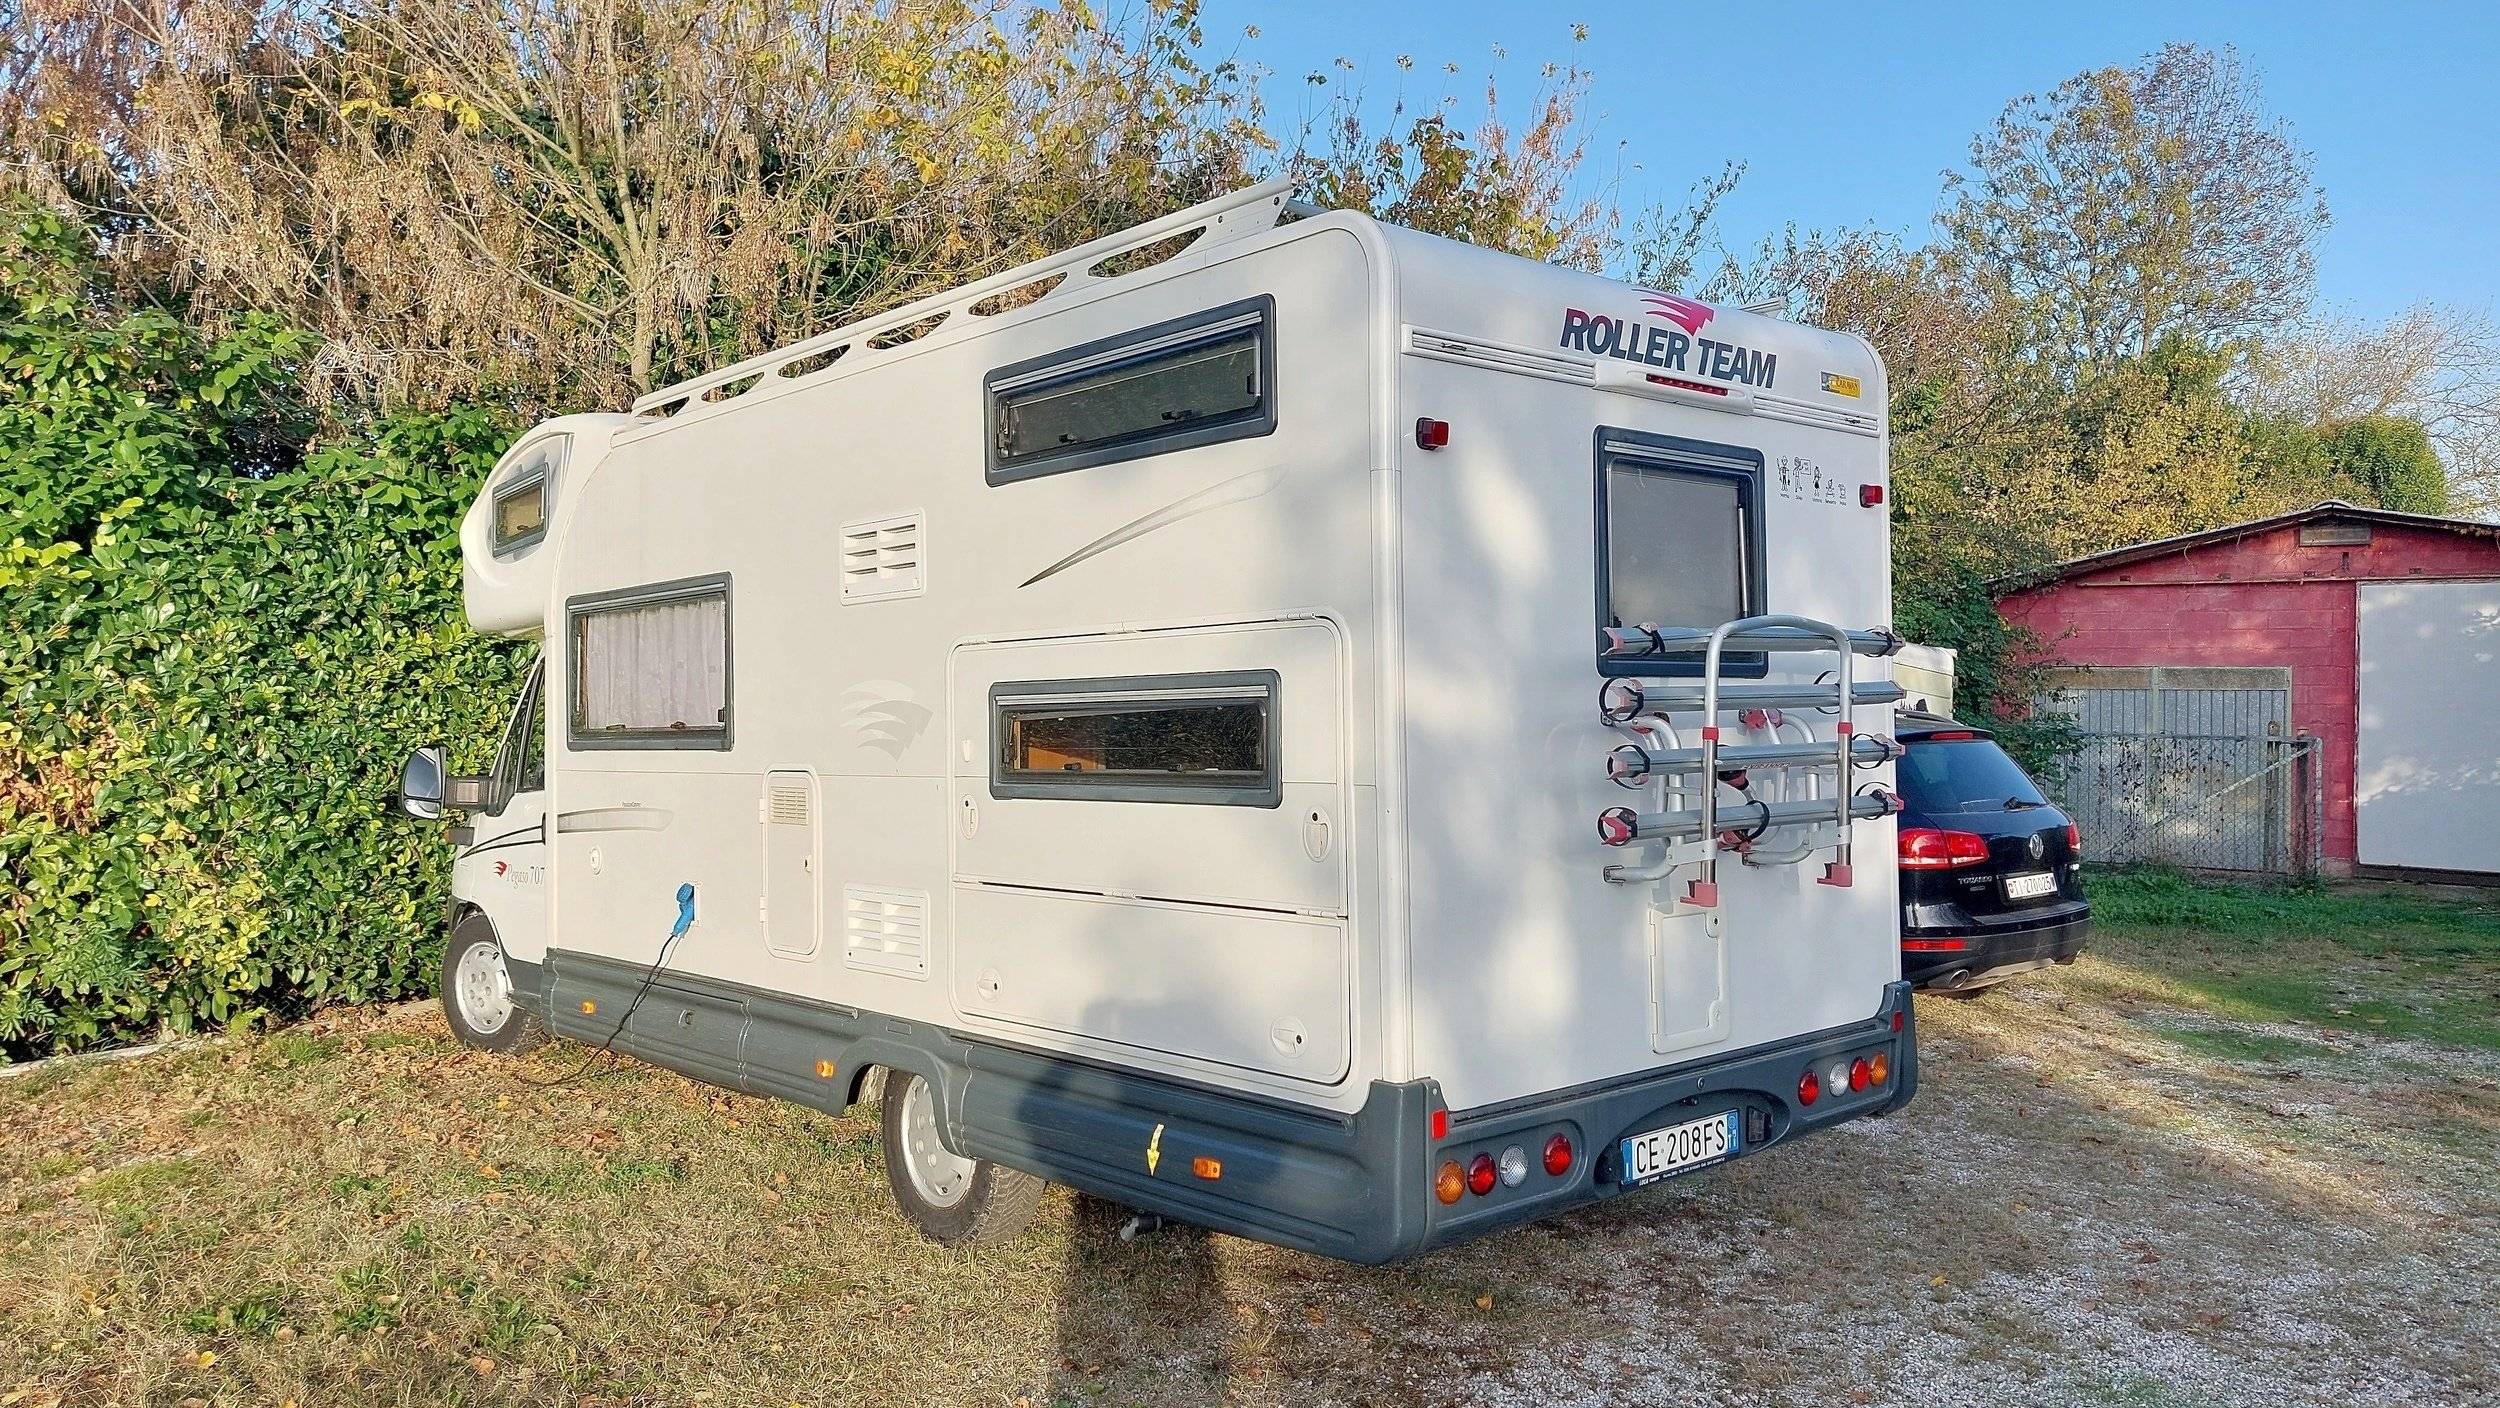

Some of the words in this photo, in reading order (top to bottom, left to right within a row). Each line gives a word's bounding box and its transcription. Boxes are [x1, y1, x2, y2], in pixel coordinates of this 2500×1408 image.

[1560, 307, 1691, 372] ROLLER
[1697, 337, 1778, 389] TEAM
[530, 865, 545, 886] 707
[1636, 1137, 1659, 1174] CE
[1667, 1119, 1725, 1165] 208FS
